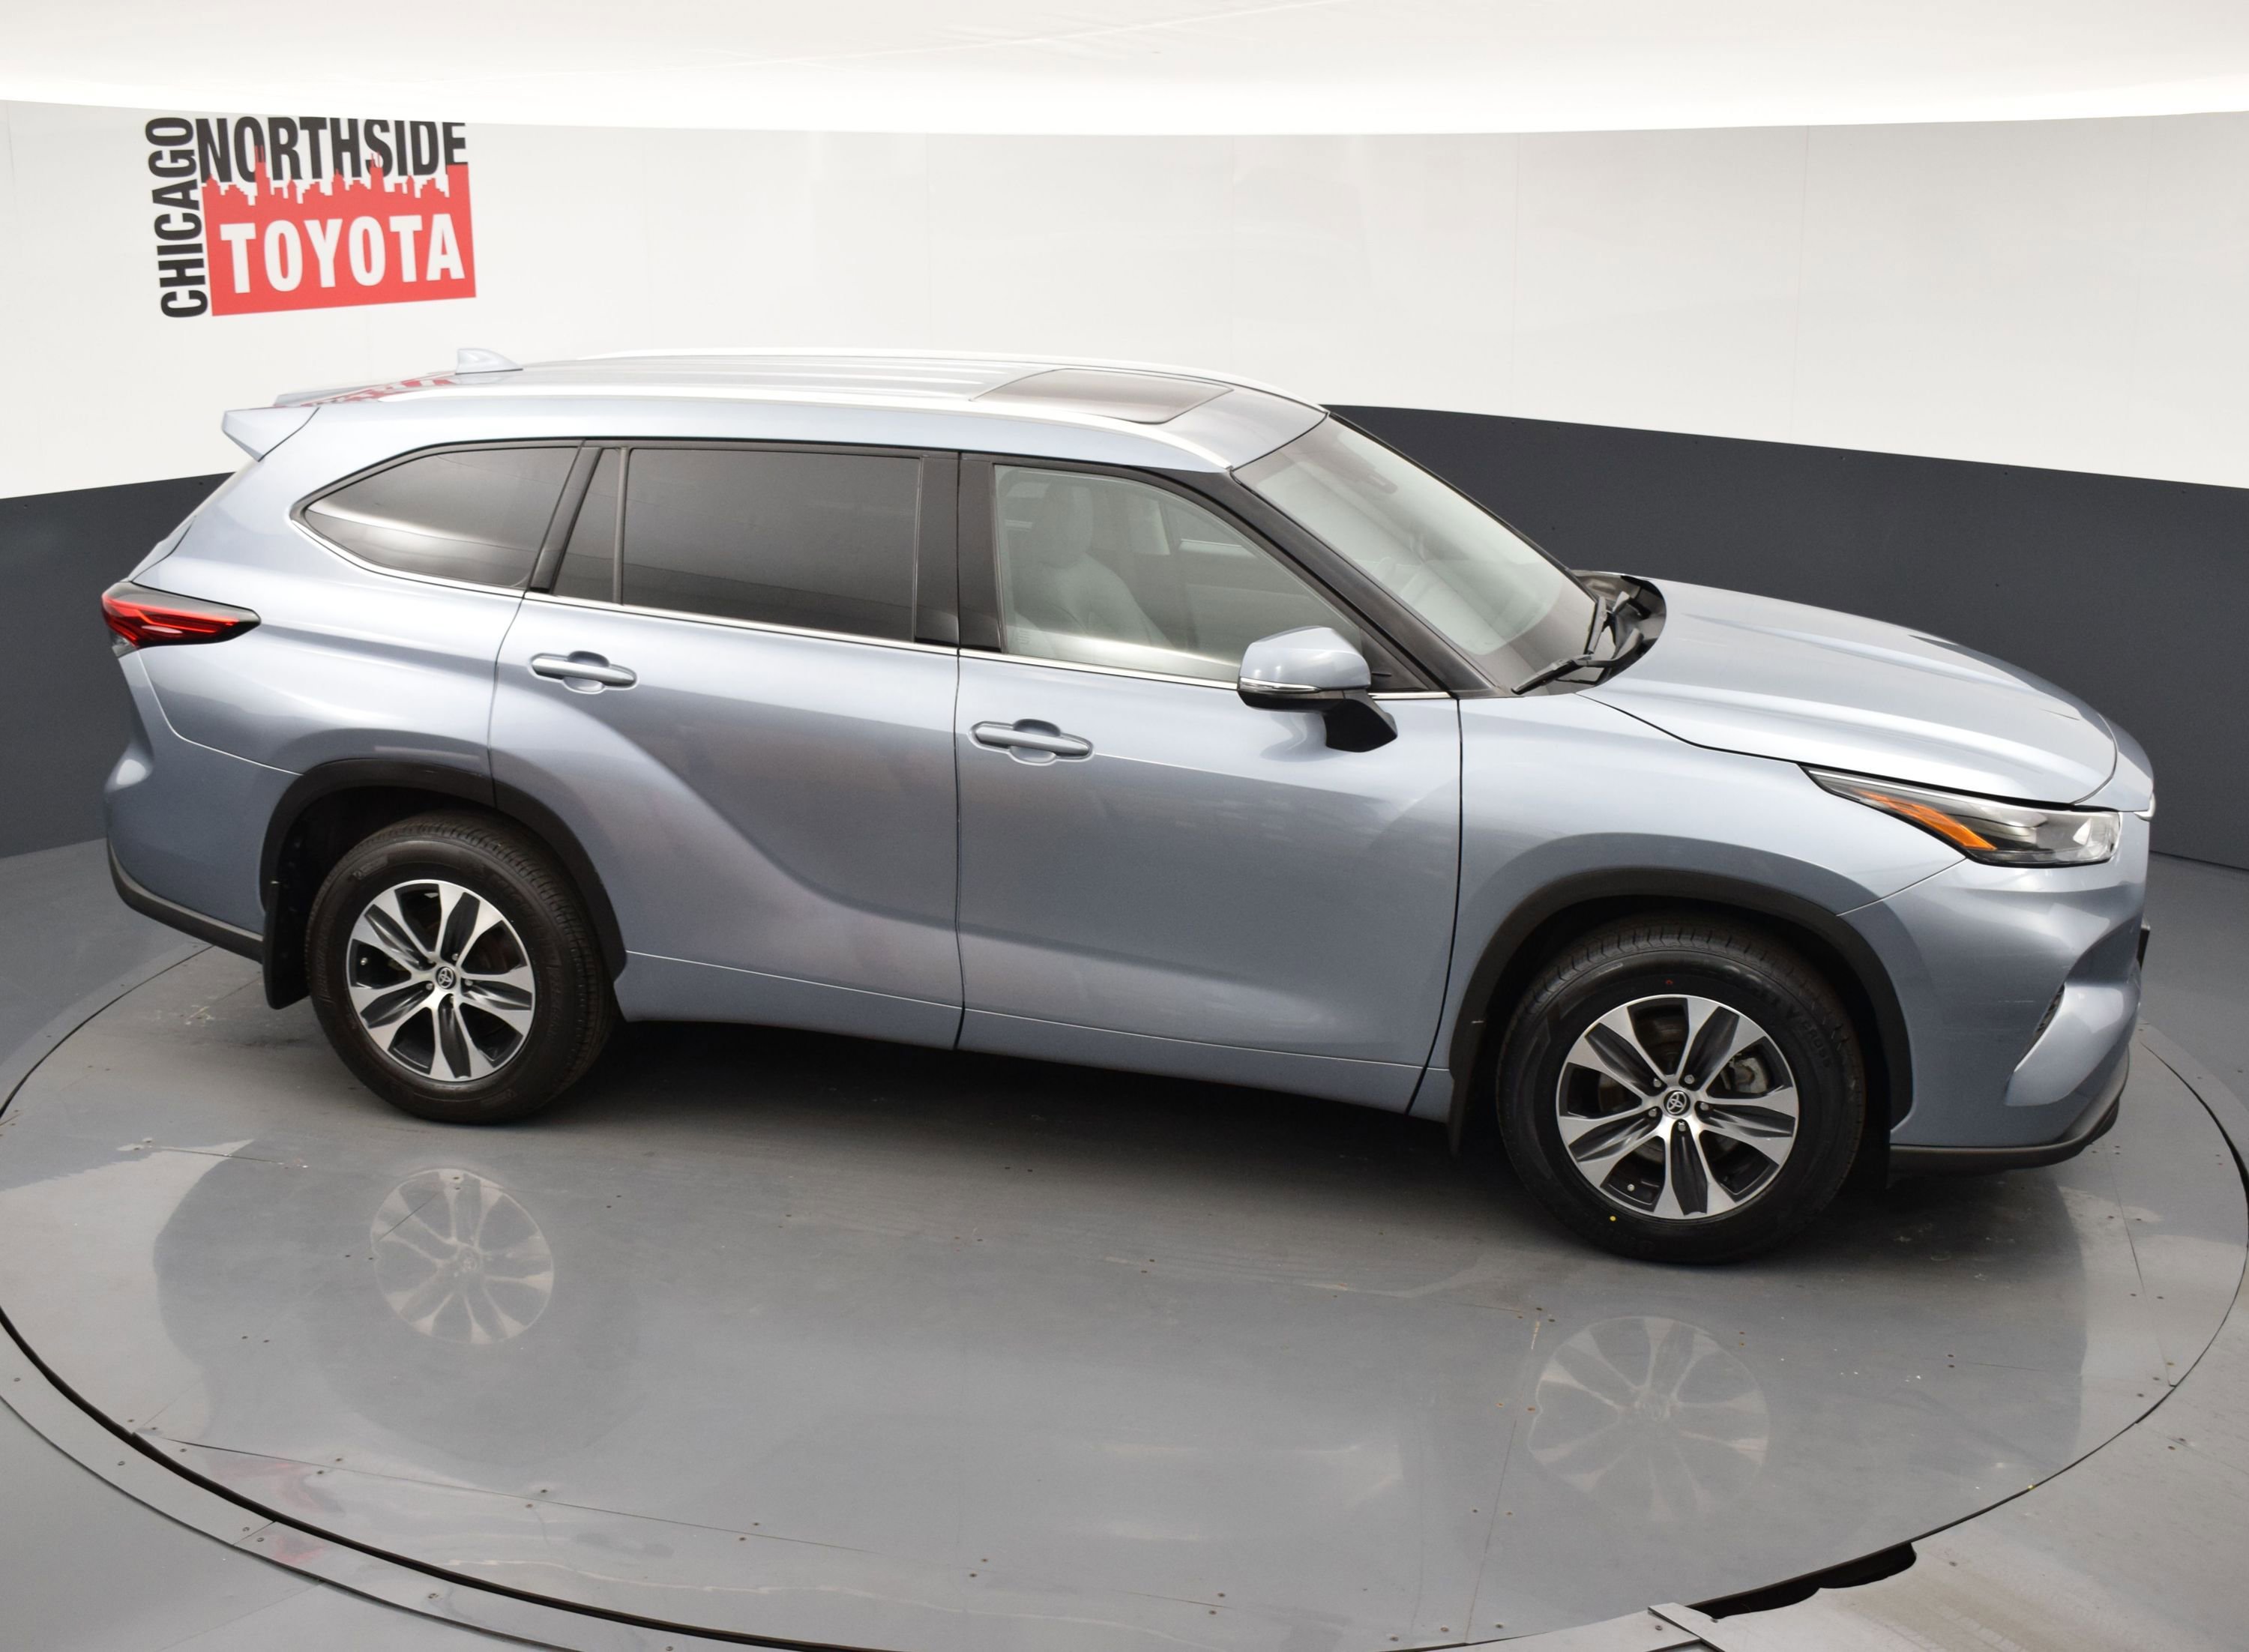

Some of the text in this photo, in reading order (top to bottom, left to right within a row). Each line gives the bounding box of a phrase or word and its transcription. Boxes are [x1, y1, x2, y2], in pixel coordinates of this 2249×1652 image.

[195, 116, 469, 182] NORTHSIDE
[145, 117, 208, 318] CHICAGO
[220, 214, 466, 294] TOYOTA
